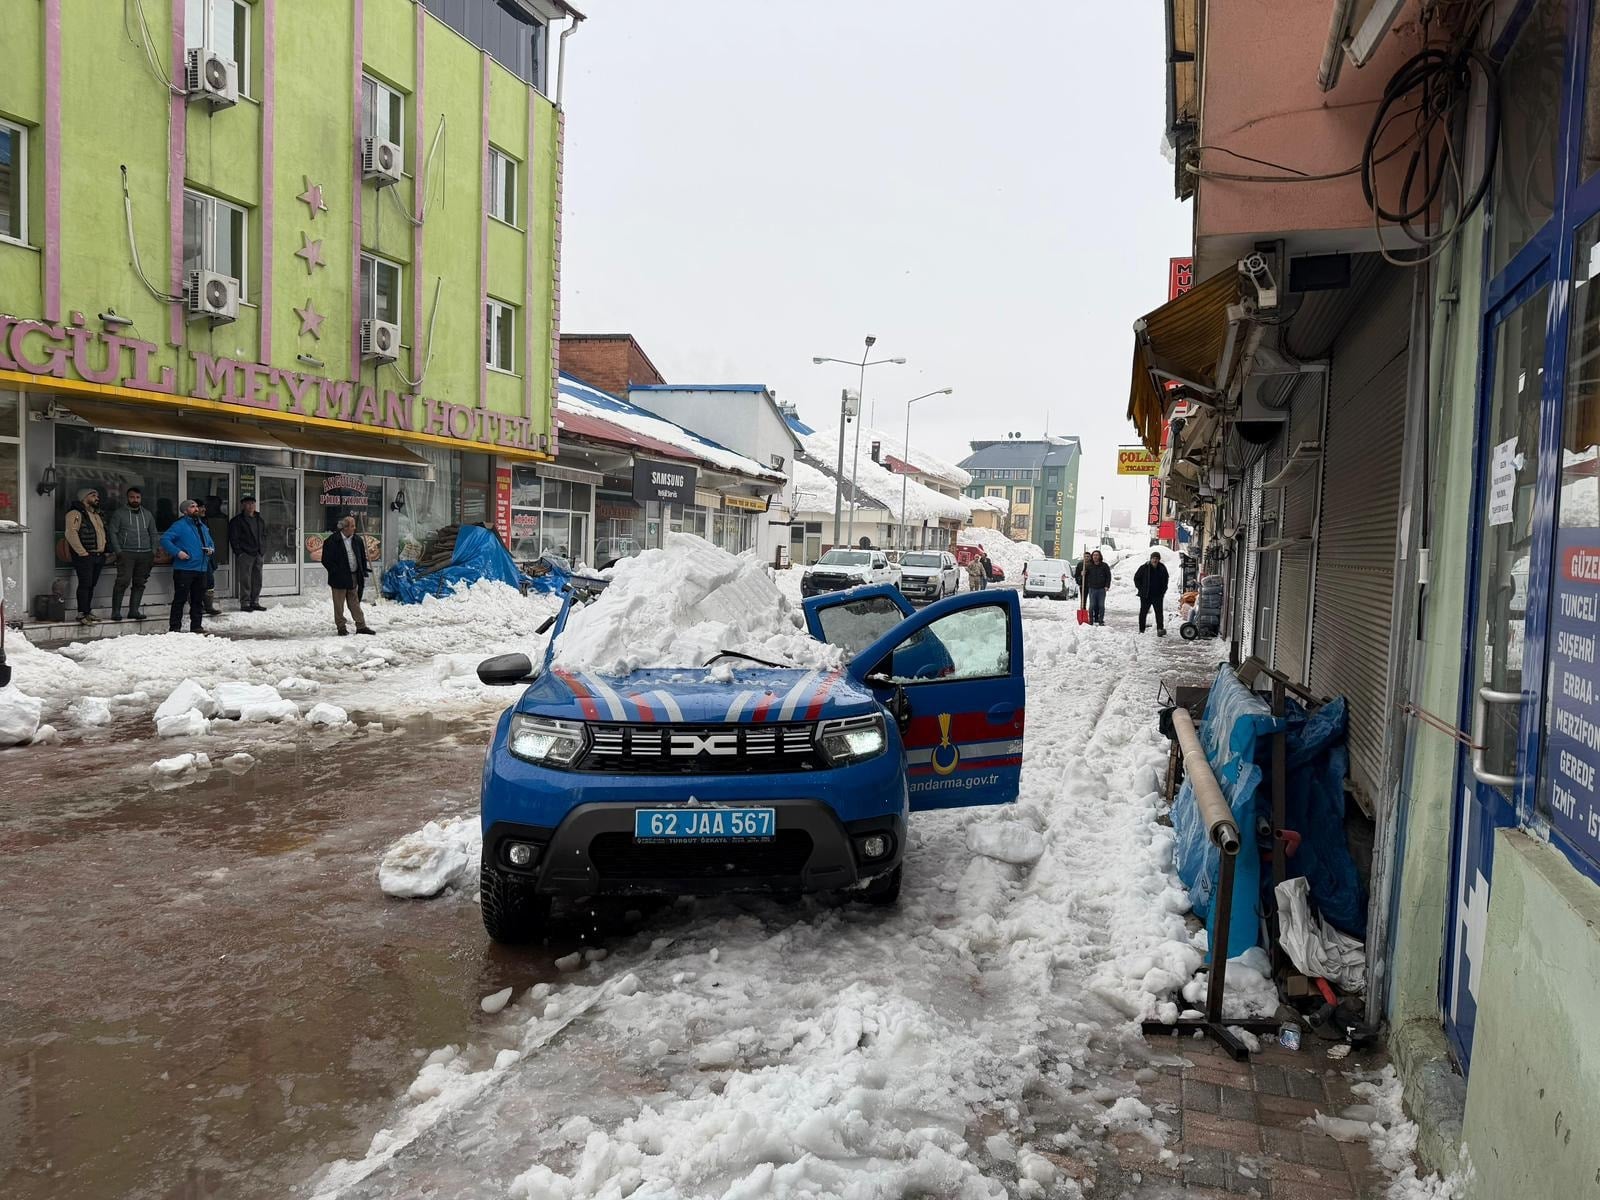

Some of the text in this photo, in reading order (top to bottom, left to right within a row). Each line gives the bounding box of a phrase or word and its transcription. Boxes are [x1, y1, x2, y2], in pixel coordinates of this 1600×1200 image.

[190, 350, 414, 431] MEYMAN
[422, 398, 539, 451] HOTEL
[651, 471, 685, 487] SAMSUNG
[1150, 478, 1160, 524] KASAP
[1570, 549, 1600, 580] GÜZE
[1560, 592, 1598, 622] TUNCELİ
[1557, 631, 1596, 664] SUŞEHRİ
[1563, 671, 1592, 705] ERBAA
[1556, 707, 1600, 752] MERZİFON
[909, 773, 999, 792] andarma.gov.tr
[1560, 750, 1596, 792] GEREDE
[1552, 779, 1576, 820] İZMİT
[651, 812, 770, 835] 62 JAA 567
